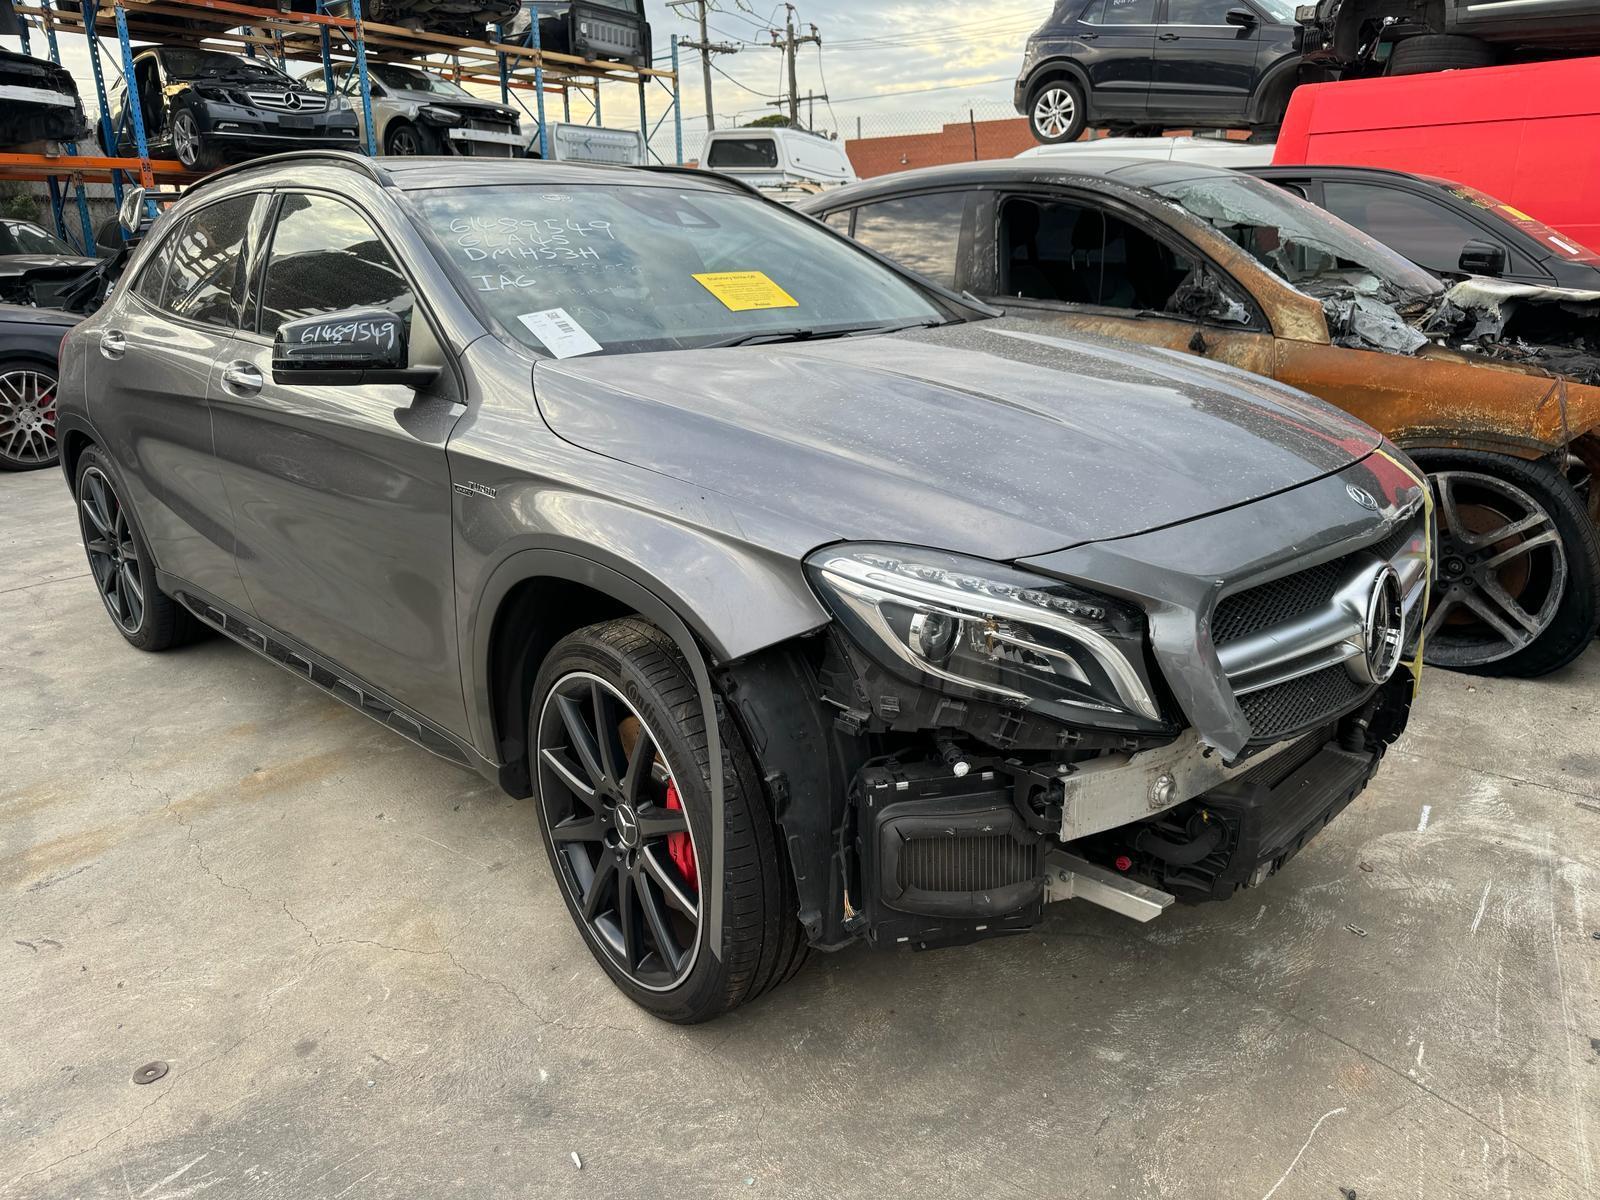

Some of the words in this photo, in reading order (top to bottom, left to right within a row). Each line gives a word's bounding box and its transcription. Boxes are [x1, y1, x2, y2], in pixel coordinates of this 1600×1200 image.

[450, 217, 614, 239] 61489549
[471, 274, 537, 292] IAG
[301, 321, 396, 350] 61489549
[468, 480, 496, 498] TURBO
